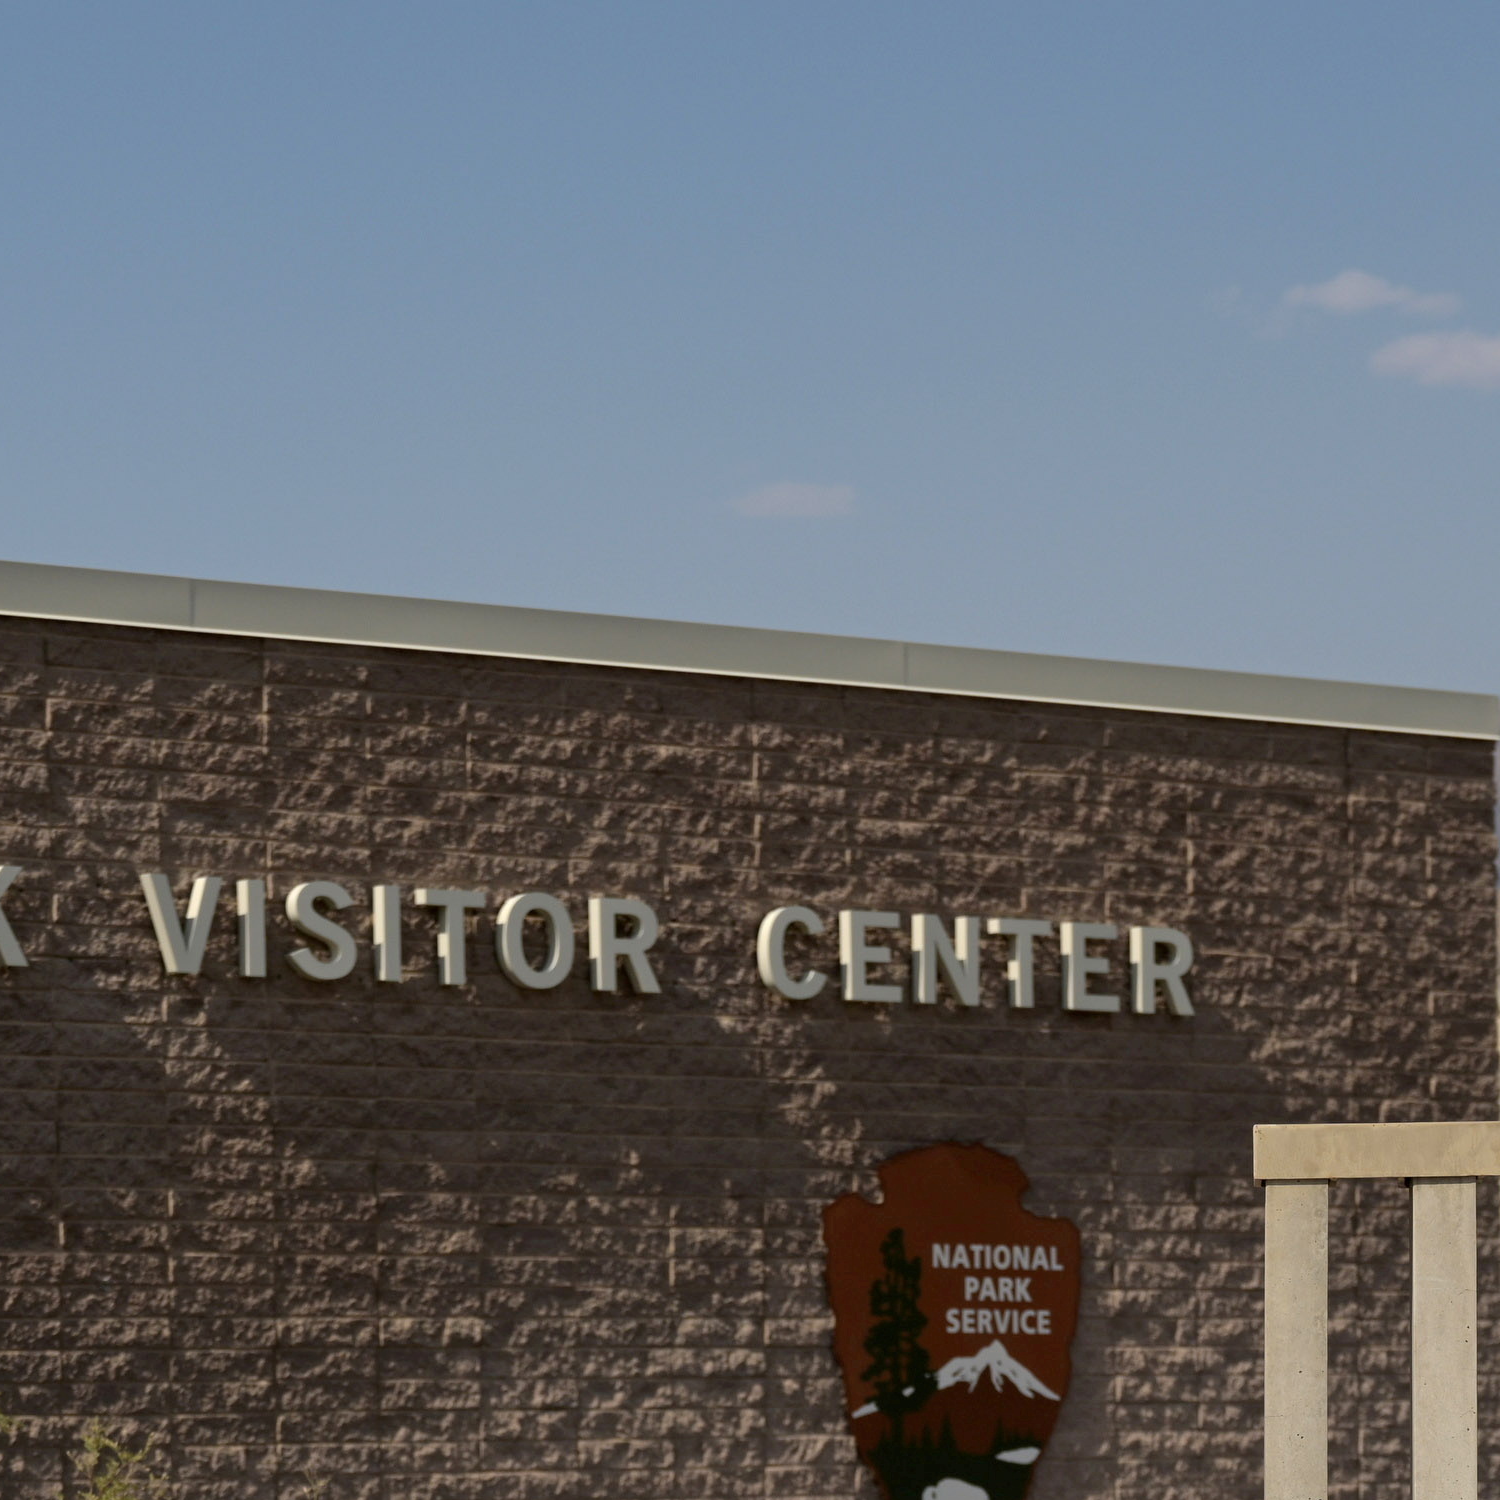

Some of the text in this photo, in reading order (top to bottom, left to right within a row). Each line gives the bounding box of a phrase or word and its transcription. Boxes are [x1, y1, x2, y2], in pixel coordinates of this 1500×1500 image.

[140, 872, 661, 994] VISITOR
[756, 905, 1195, 1015] CENTER
[931, 1243, 1065, 1271] NATIONAL
[964, 1276, 1033, 1302] PARK
[945, 1308, 1052, 1334] SERVICE
